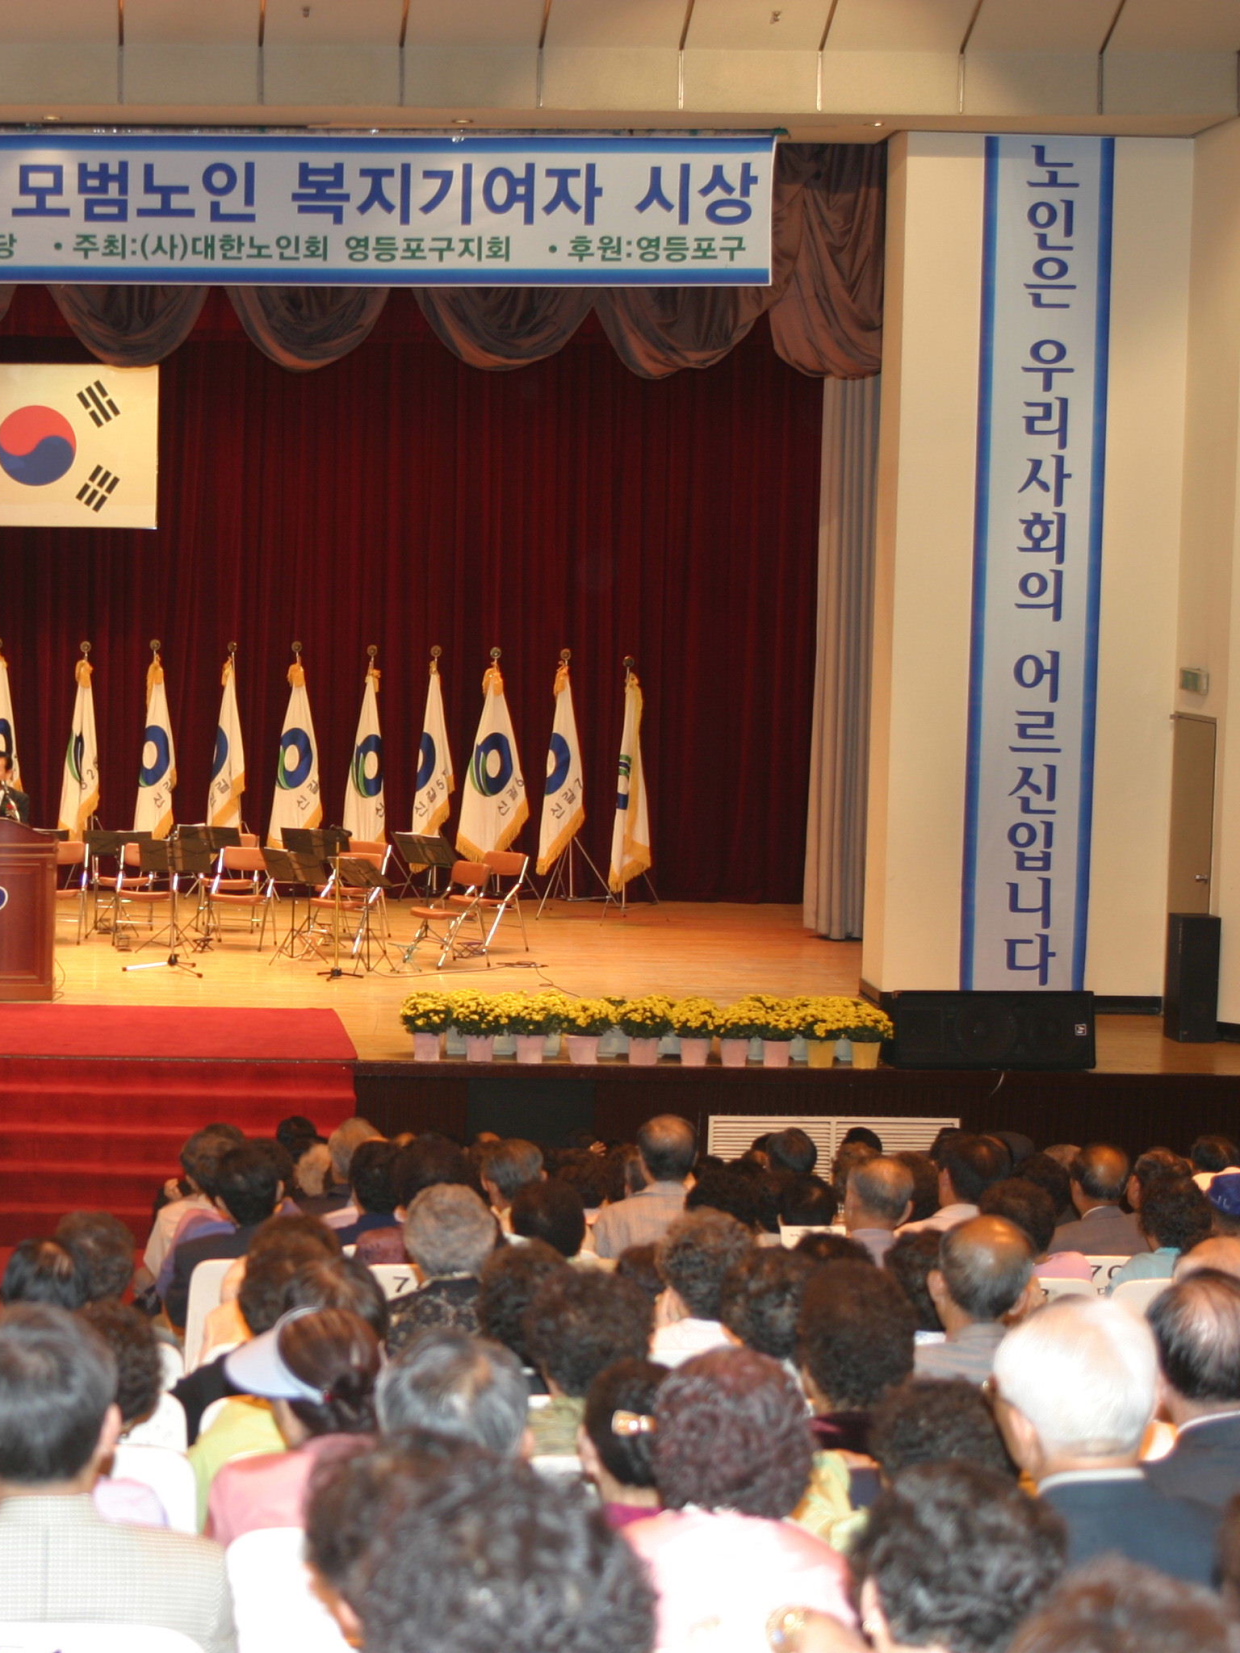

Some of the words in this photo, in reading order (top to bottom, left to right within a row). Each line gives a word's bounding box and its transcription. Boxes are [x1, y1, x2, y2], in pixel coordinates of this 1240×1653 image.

[11, 160, 257, 223] 모범노인
[291, 161, 604, 226] 복지기여자
[634, 161, 759, 226] 시상
[72, 233, 329, 262] 주최:(사)대한노인회
[344, 235, 511, 263] 영등포구지회
[567, 235, 747, 263] 후원:영등포구
[1023, 144, 1080, 309] 노인은
[1014, 338, 1076, 623] 우리사회의
[1004, 649, 1062, 987] 어르신입니다
